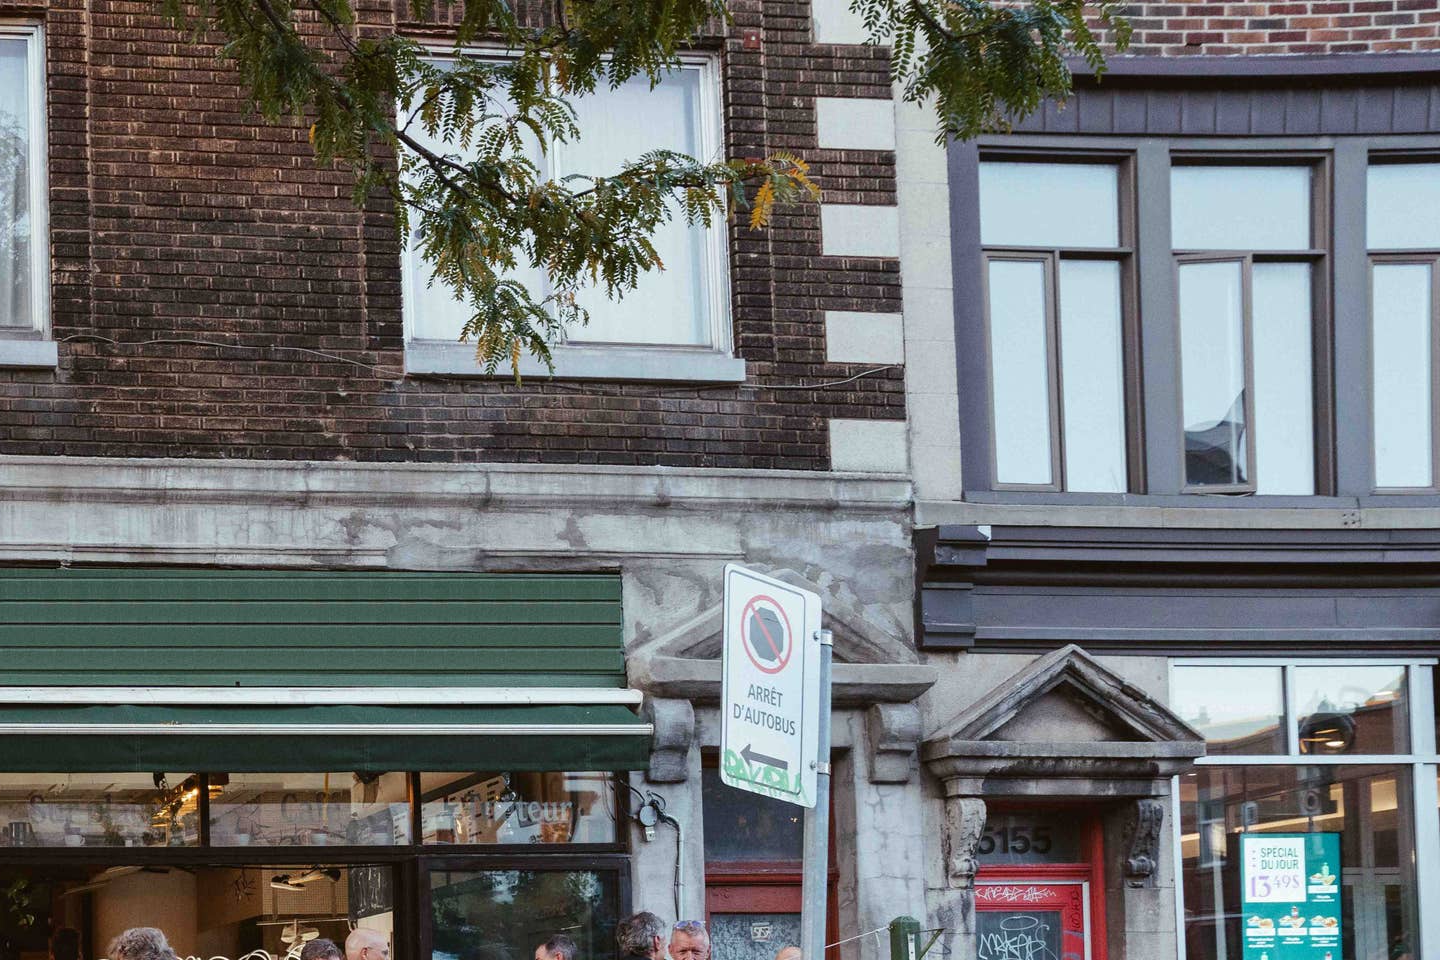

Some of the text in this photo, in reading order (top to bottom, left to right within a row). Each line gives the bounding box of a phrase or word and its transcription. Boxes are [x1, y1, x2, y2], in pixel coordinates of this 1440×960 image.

[747, 683, 783, 708] ARRÊT
[733, 703, 795, 736] D'AUTOBUS
[979, 826, 1052, 855] 5155
[1261, 860, 1299, 869] DU JOUR
